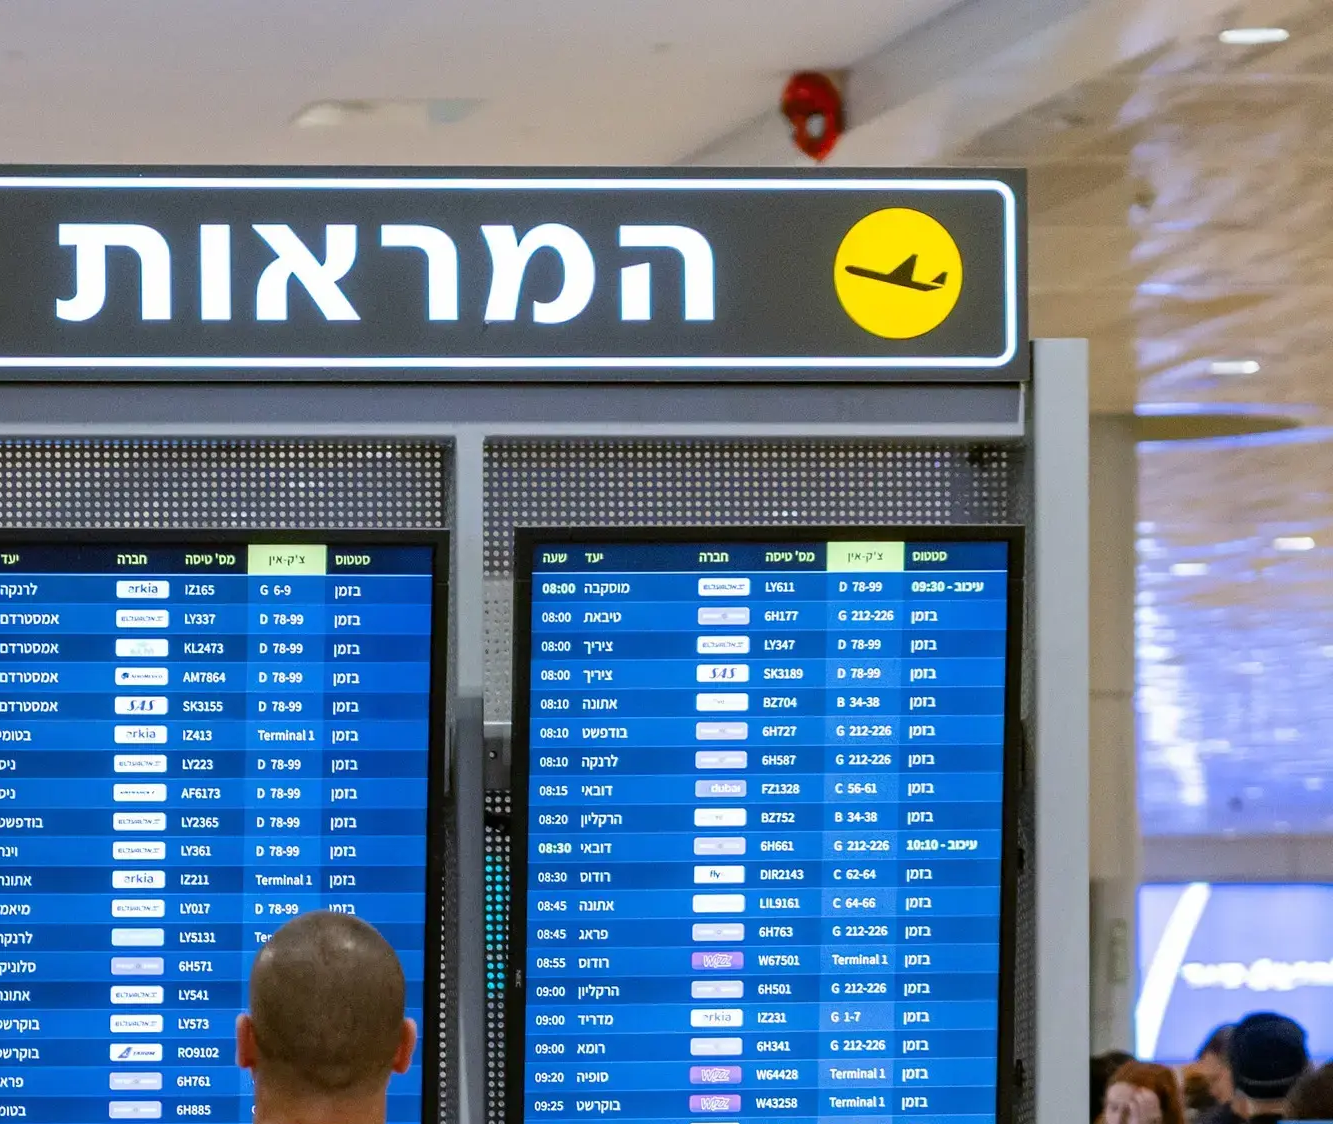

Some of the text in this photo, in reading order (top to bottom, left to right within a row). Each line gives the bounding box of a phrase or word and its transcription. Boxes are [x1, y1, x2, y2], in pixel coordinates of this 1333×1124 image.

[56, 223, 714, 324] המראות
[0, 554, 19, 565] יעד
[117, 554, 148, 565] חברה
[185, 554, 213, 565] טיסה
[335, 555, 371, 566] סטטוס
[542, 553, 567, 563] שעה
[584, 553, 604, 563] יעד
[699, 552, 729, 563] חברה
[765, 552, 793, 562] טיסה
[912, 551, 948, 562] סטטוס
[0, 582, 38, 599] לרנקה
[185, 584, 215, 596] IZ165
[260, 584, 269, 596] G
[273, 584, 291, 596] 6-9
[334, 585, 362, 600] בזמן
[542, 583, 576, 594] 08:00
[584, 583, 630, 597] מוסקבה
[765, 581, 795, 593] LY611
[839, 581, 848, 592] D
[852, 581, 883, 592] 78-99
[540, 696, 936, 711] 08:10 אתונה BZ704 B 34-38 בזמן
[181, 817, 219, 828] LY2365
[256, 816, 265, 828] D
[269, 816, 300, 828] 78-99
[330, 817, 357, 831] בזמן
[177, 1047, 219, 1059] RO9102
[534, 1072, 565, 1083] 09:20
[576, 1071, 609, 1083] סופיה
[829, 1067, 878, 1080] Terminal
[878, 1067, 886, 1080] 1
[902, 1068, 929, 1082] בזמן
